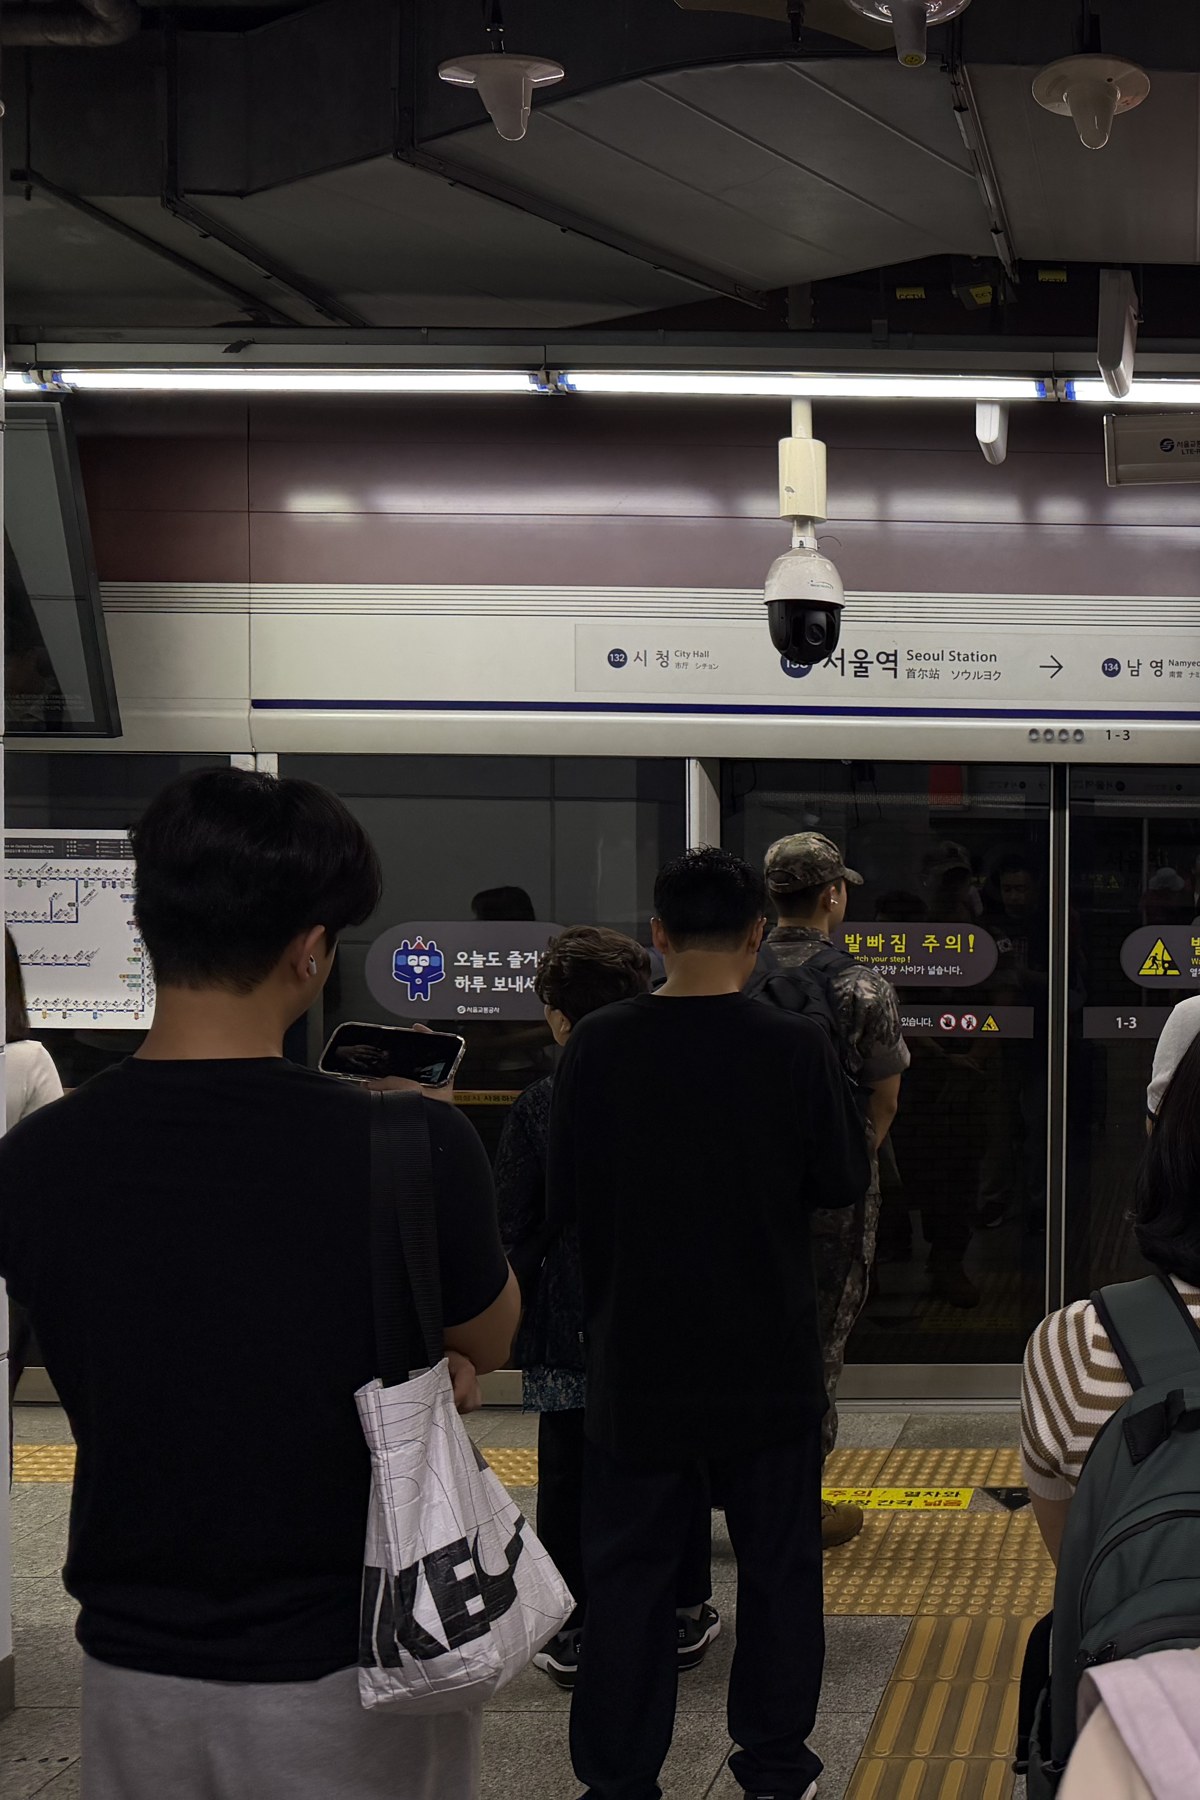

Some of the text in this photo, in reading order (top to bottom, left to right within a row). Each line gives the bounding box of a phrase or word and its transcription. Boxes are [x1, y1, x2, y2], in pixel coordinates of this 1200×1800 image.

[609, 653, 625, 662] 132
[634, 650, 670, 668] 시청
[675, 650, 691, 659] City
[907, 650, 997, 662] Seoul Station
[823, 648, 898, 679] 서울역
[1103, 663, 1119, 672] 134
[1127, 659, 1163, 677] 남영
[906, 668, 940, 680] 首尔站
[952, 669, 1002, 681] ソウルヨク
[1106, 729, 1130, 741] 1-3
[844, 933, 976, 953] 발빠짐 주의!
[454, 950, 543, 968] 오늘도 즐거
[854, 955, 869, 963] tch
[871, 956, 888, 964] your
[900, 965, 925, 975] 사이가
[454, 975, 487, 993] 하루
[901, 1016, 934, 1027] 있습니다.
[1116, 1017, 1137, 1029] 1-3
[904, 1490, 960, 1498] 열차와
